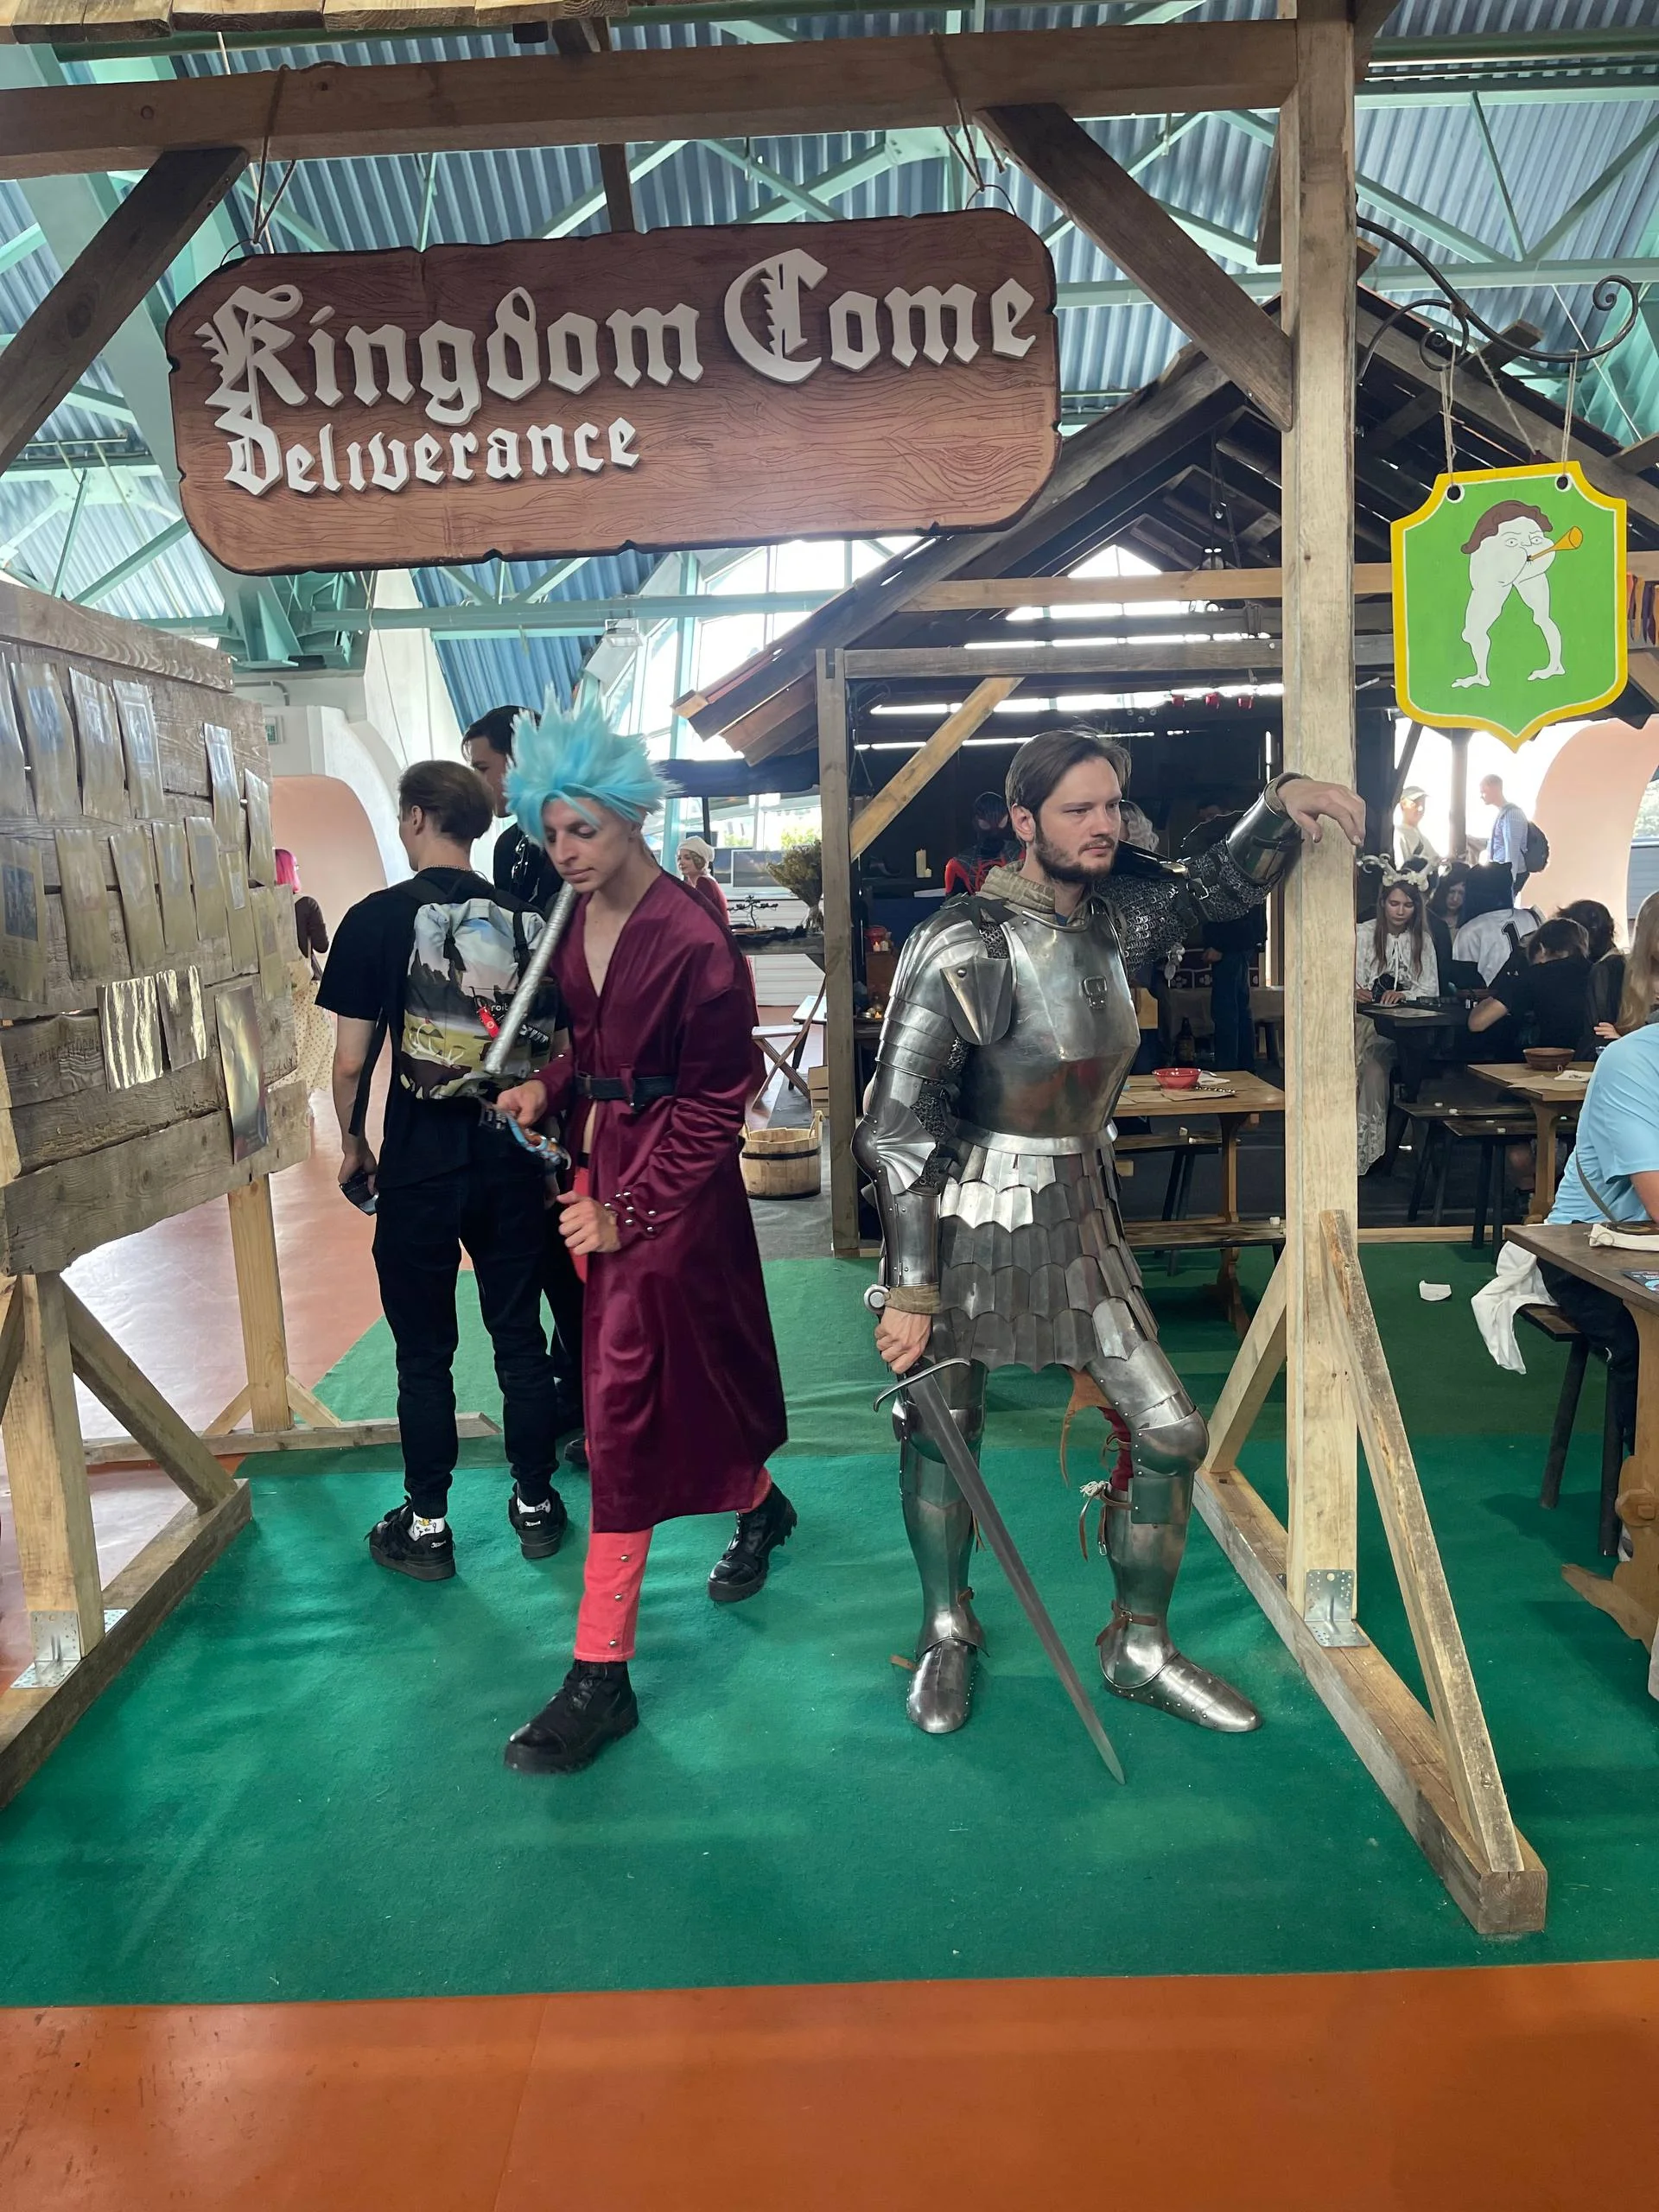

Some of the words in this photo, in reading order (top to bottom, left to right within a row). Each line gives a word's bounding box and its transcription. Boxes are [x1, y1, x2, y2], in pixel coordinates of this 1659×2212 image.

[195, 283, 704, 427] Kingdom
[723, 248, 1037, 385] Come
[214, 410, 640, 498] Deliverance
